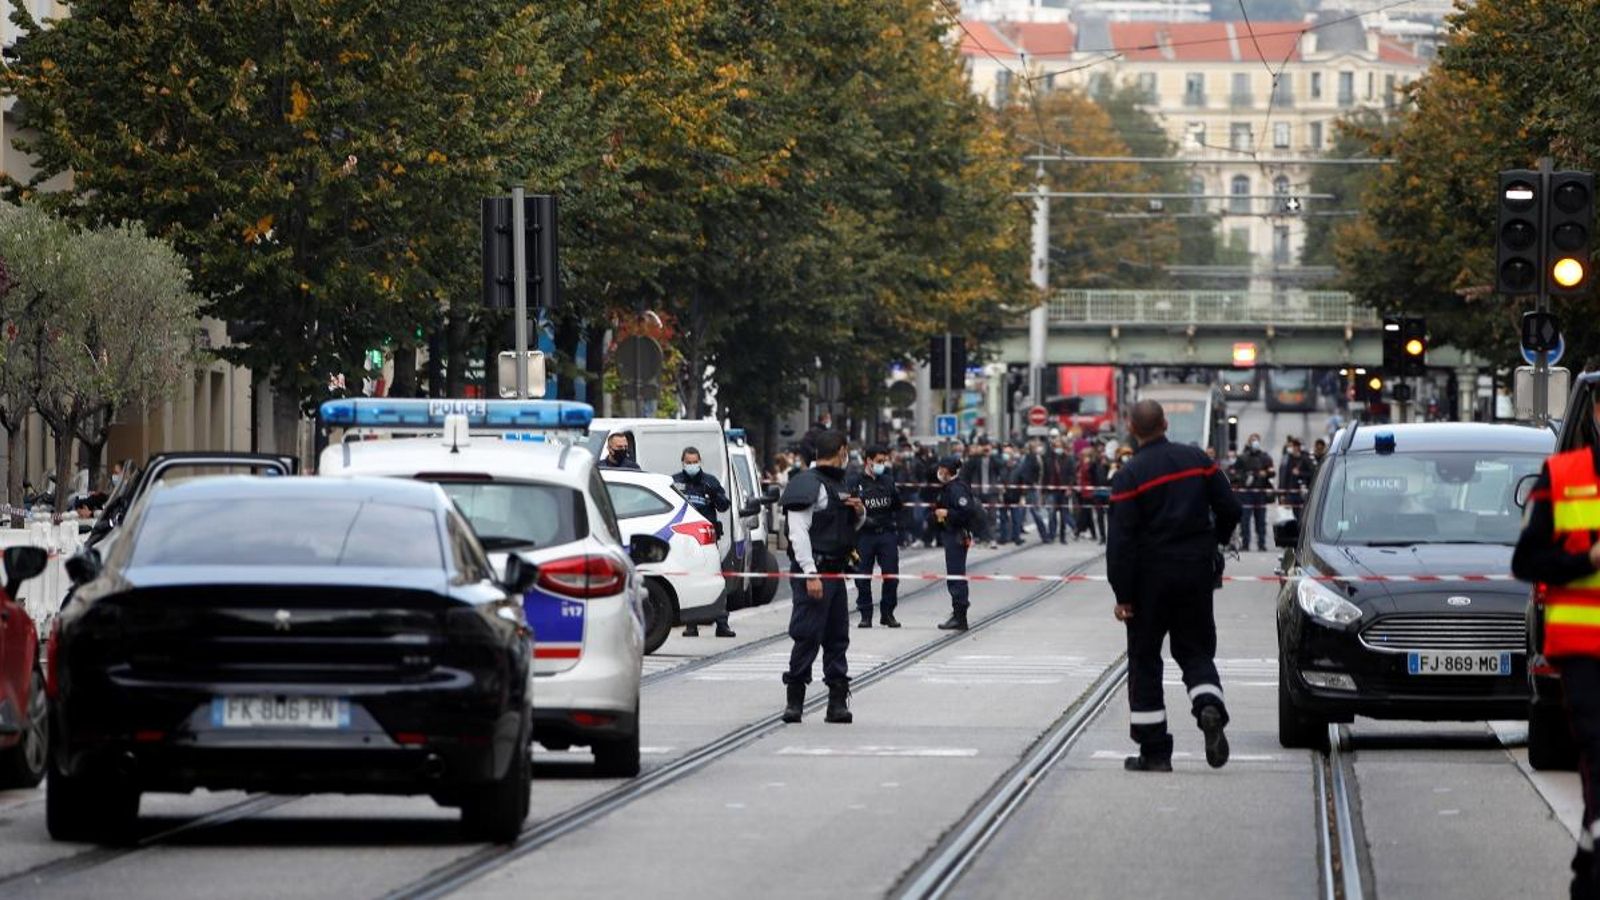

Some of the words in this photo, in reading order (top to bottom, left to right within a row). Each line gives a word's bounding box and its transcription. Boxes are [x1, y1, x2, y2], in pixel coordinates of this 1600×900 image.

[432, 402, 484, 415] POLICE
[1360, 479, 1401, 489] POLICE
[865, 497, 891, 508] POLIC
